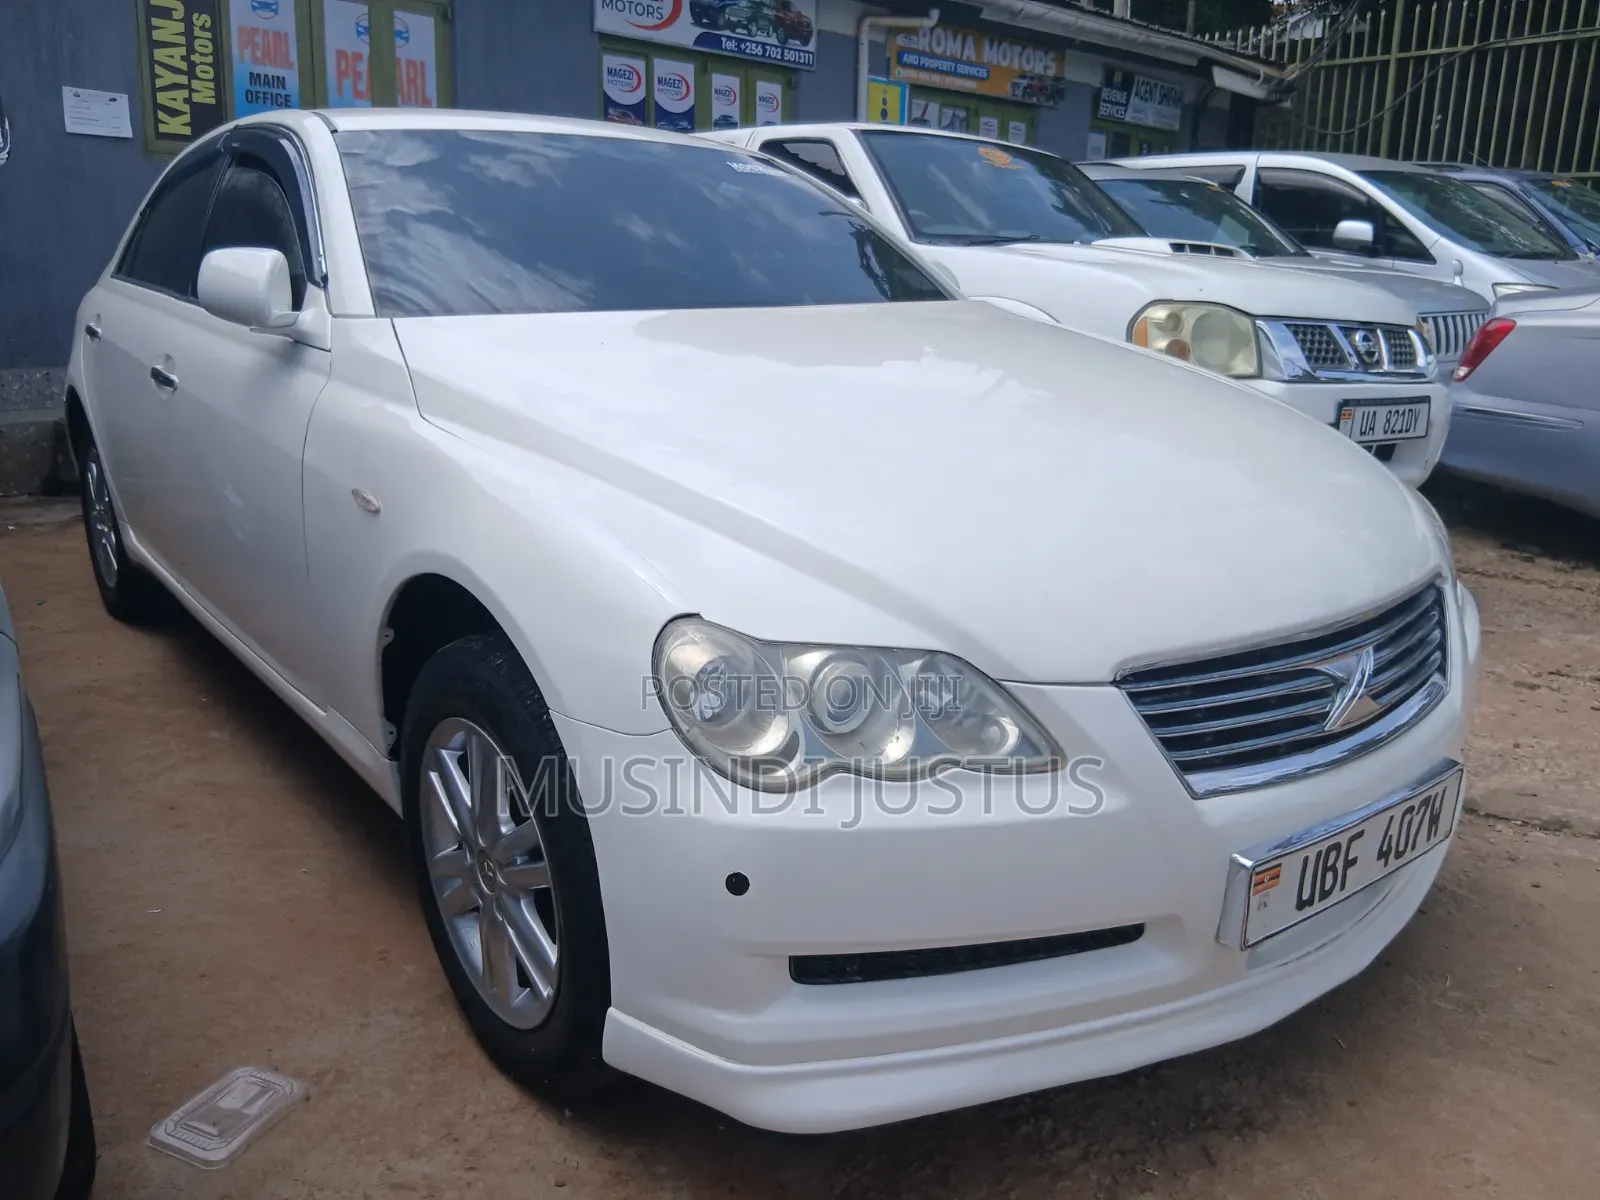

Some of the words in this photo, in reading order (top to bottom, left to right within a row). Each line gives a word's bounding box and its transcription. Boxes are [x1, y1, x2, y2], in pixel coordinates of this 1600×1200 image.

[601, 0, 664, 21] MOTORS
[191, 13, 216, 105] Motors
[237, 25, 294, 70] PEARL
[721, 38, 738, 51] Tel:
[740, 42, 763, 56] +256
[765, 46, 782, 60] 702
[784, 50, 813, 65] 501311
[919, 27, 976, 62] ROMA
[983, 39, 1056, 76] MOTORS
[903, 53, 919, 65] AND
[919, 56, 956, 72] PROPERTY
[956, 63, 988, 79] SERVICES
[248, 72, 287, 90] MAIN
[245, 89, 292, 108] OFFICE
[1100, 87, 1128, 104] REVENUE
[1099, 102, 1126, 119] SERVICES
[1360, 410, 1377, 436] UA
[1383, 408, 1421, 435] 821DY
[1295, 828, 1365, 911] UBF
[1376, 786, 1448, 868] 407W
